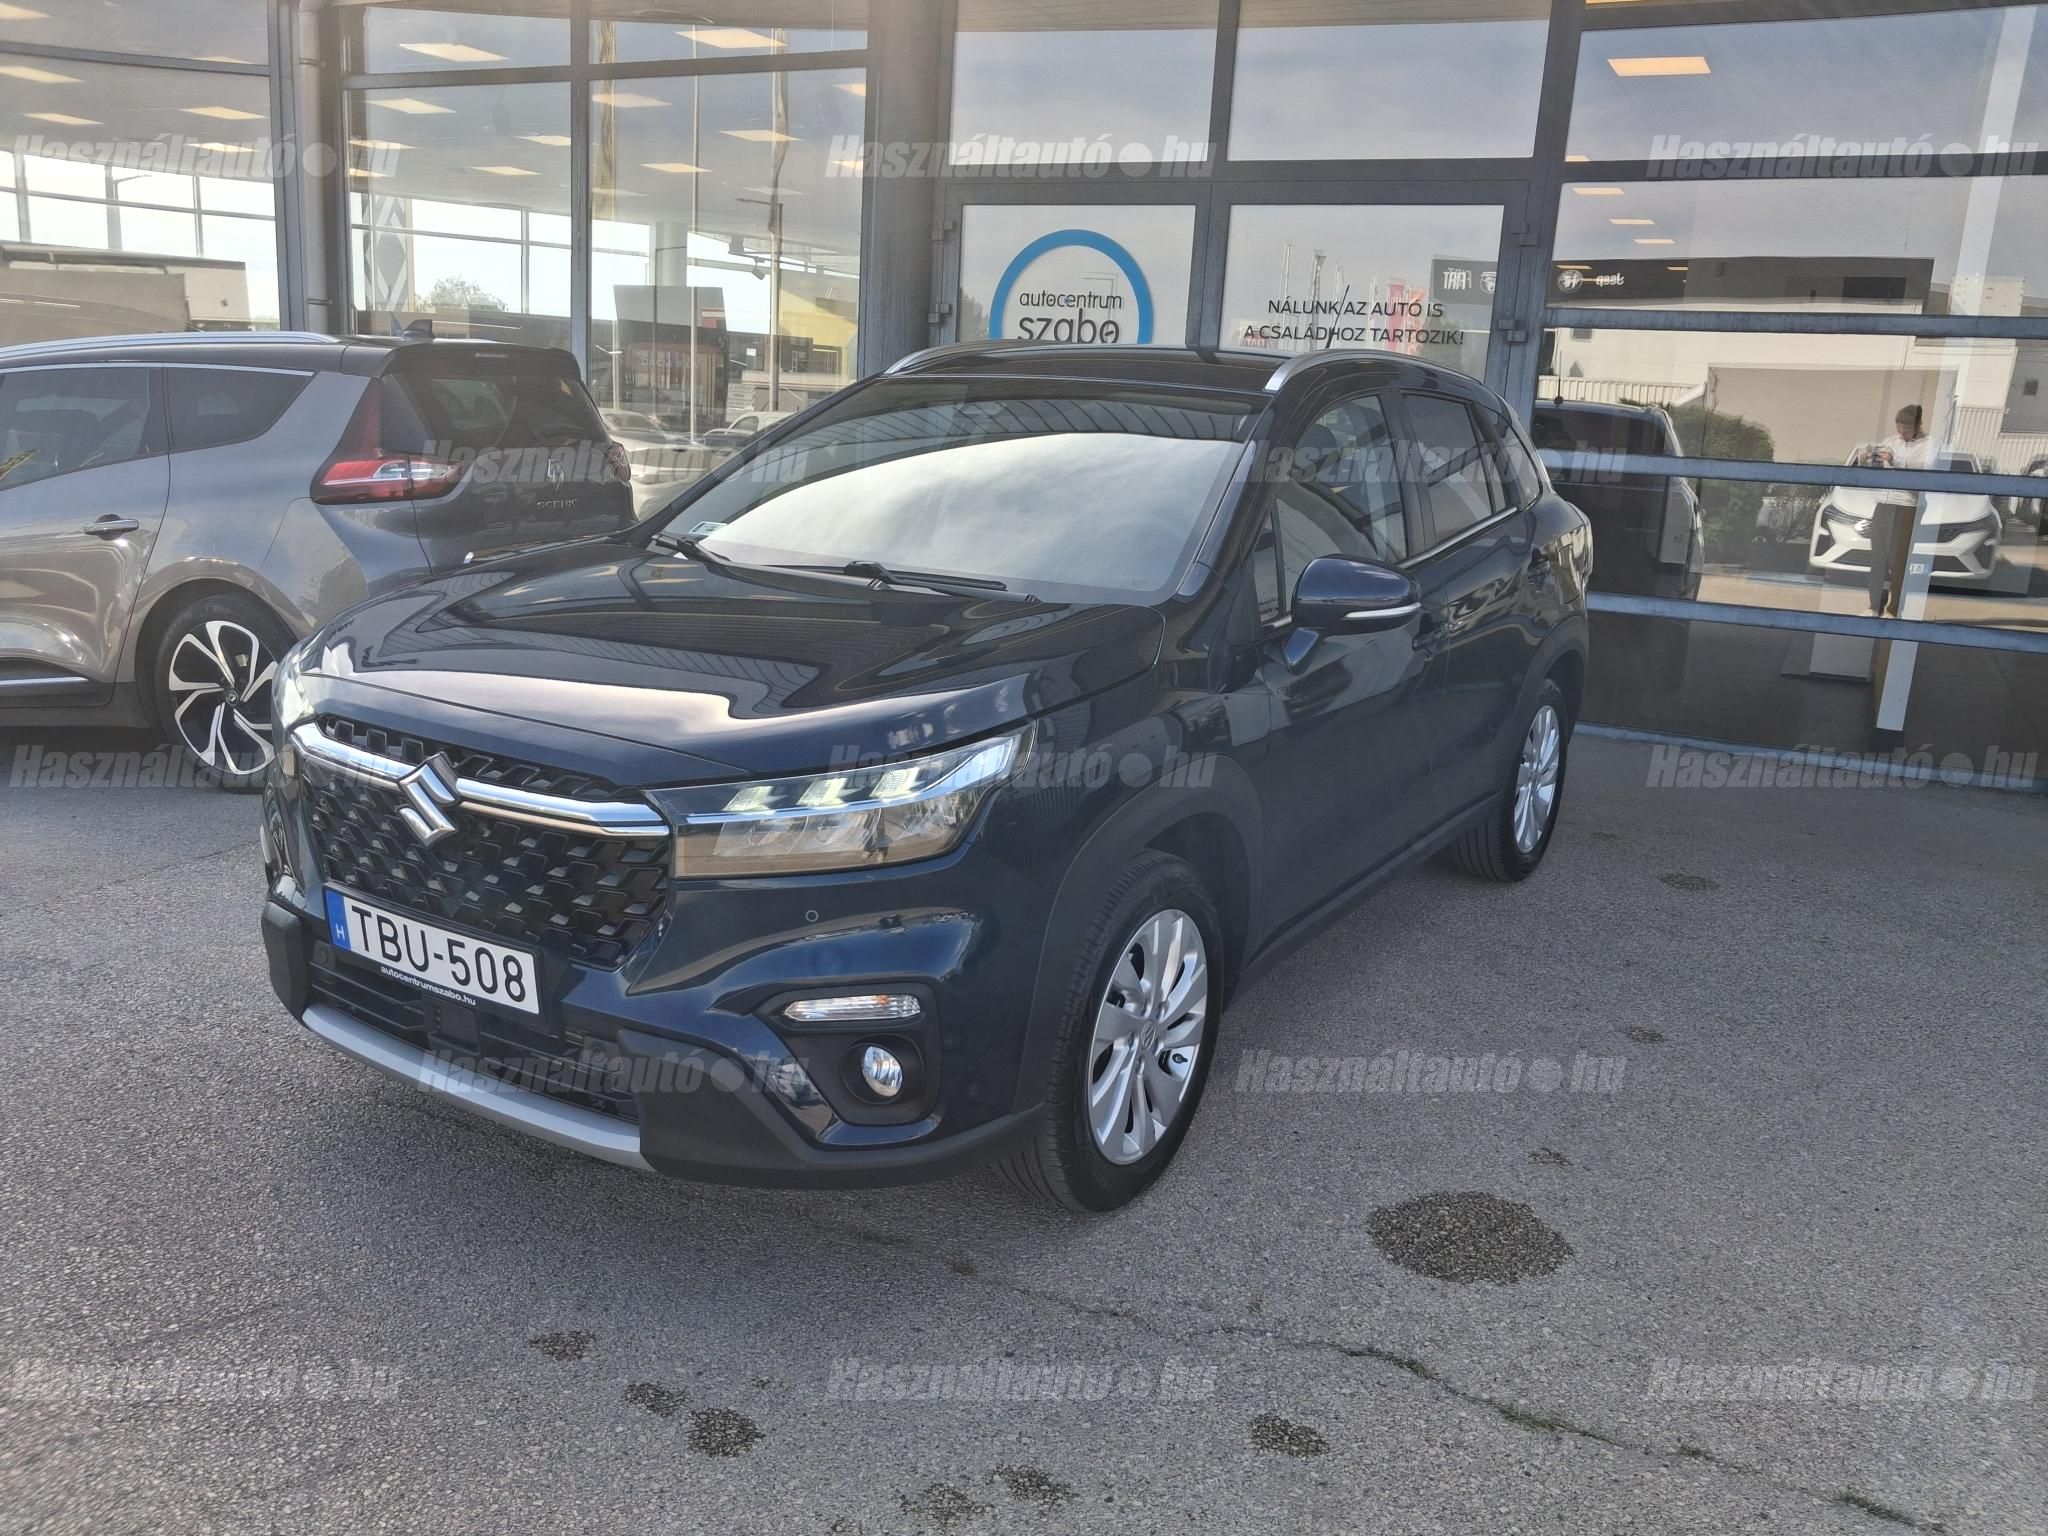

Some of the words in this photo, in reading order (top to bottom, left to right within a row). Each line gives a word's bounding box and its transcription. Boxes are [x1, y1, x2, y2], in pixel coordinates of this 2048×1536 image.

[1019, 290, 1122, 309] autocentrum
[1268, 296, 1339, 315] NÁLUNK
[1343, 302, 1367, 316] AZ
[1371, 299, 1422, 317] AUTÓ
[1426, 303, 1444, 317] IS
[1244, 325, 1255, 339] A
[1259, 323, 1365, 342] CSALÁDHOZ
[1369, 328, 1465, 345] TARTOZIK!
[335, 924, 346, 940] H
[351, 904, 526, 1003] TBU-508
[380, 965, 477, 1006] autocentrumszabo.hu
